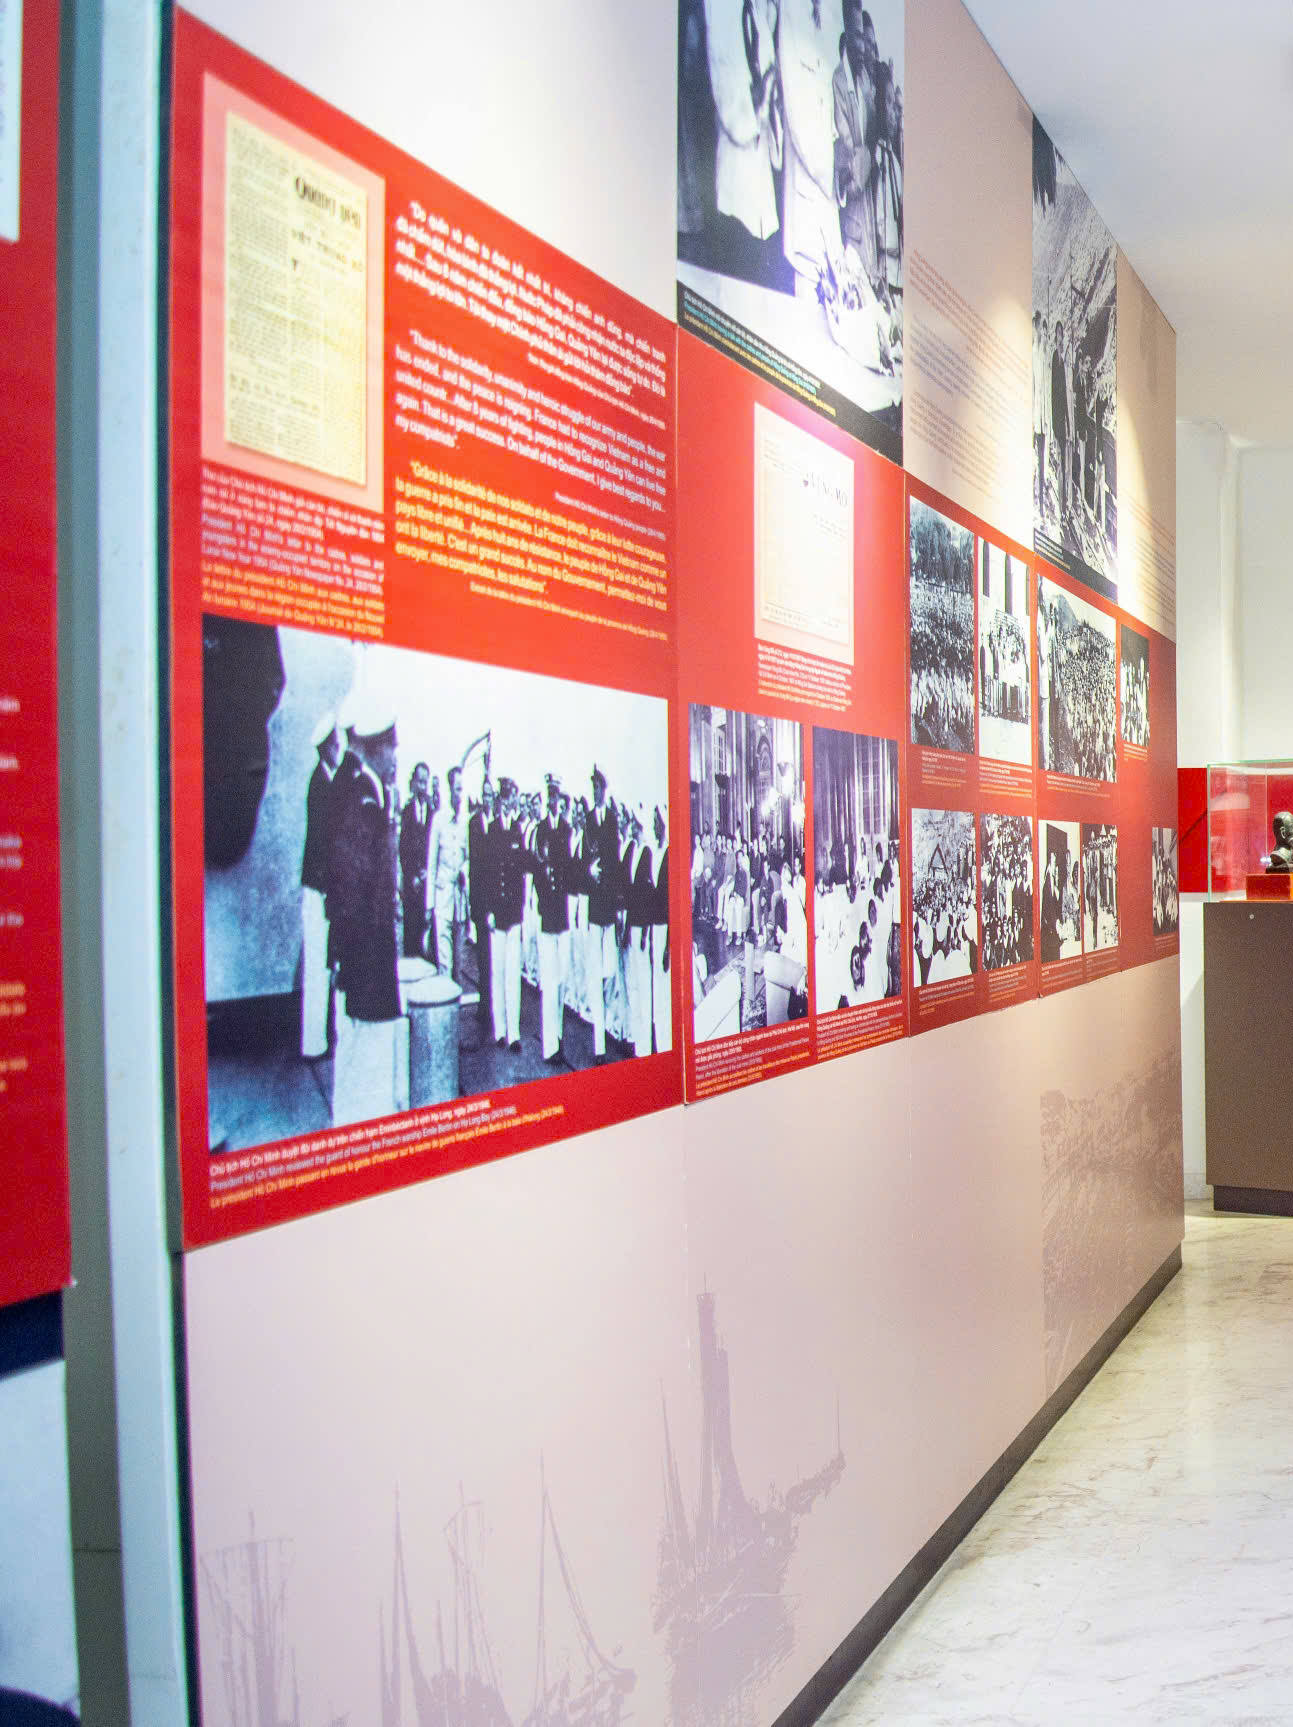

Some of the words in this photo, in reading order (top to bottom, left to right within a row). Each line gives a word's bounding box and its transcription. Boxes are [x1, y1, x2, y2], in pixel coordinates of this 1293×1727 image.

[396, 389, 418, 415] again.
[423, 401, 440, 421] That
[455, 414, 475, 438] great
[475, 425, 504, 447] success.
[518, 441, 539, 461] behalf
[546, 453, 557, 468] the
[557, 457, 594, 484] Government,
[600, 475, 612, 493] give
[612, 480, 624, 496] best
[625, 485, 644, 506] regards
[652, 499, 665, 514] you...
